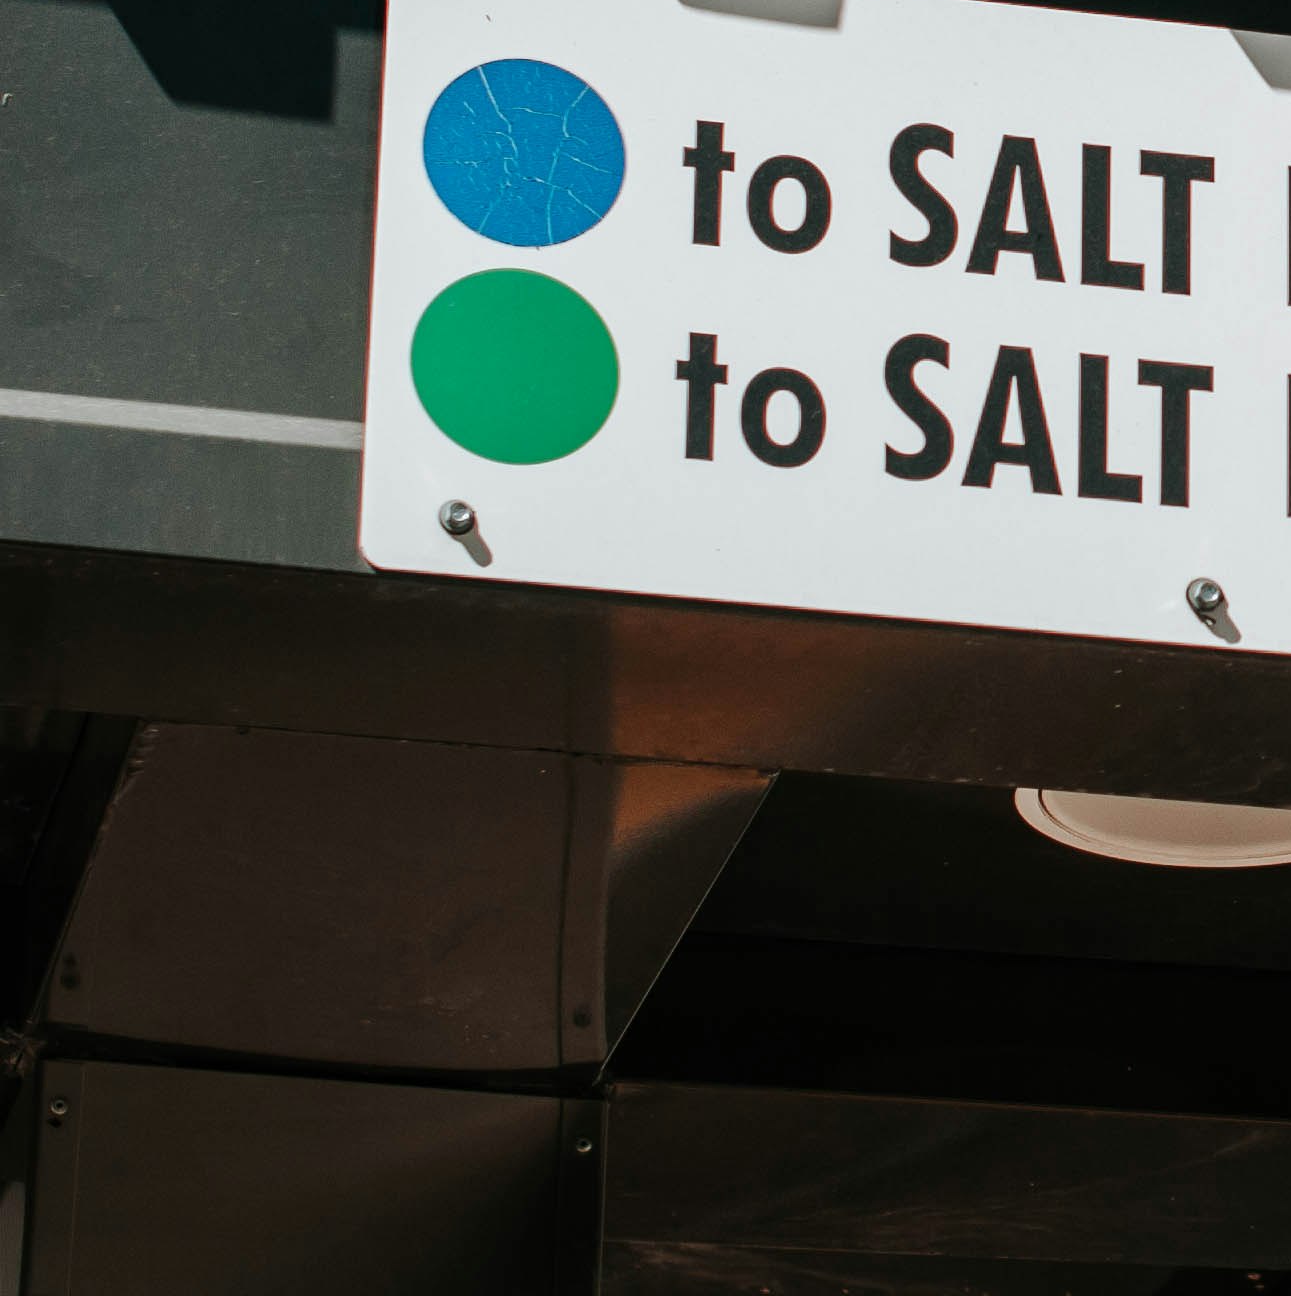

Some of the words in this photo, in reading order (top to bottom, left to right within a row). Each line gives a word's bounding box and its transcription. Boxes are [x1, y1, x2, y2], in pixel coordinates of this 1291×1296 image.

[683, 120, 832, 255] to
[889, 122, 1215, 296] SALT
[676, 332, 827, 468] to
[884, 333, 1214, 508] SALT
